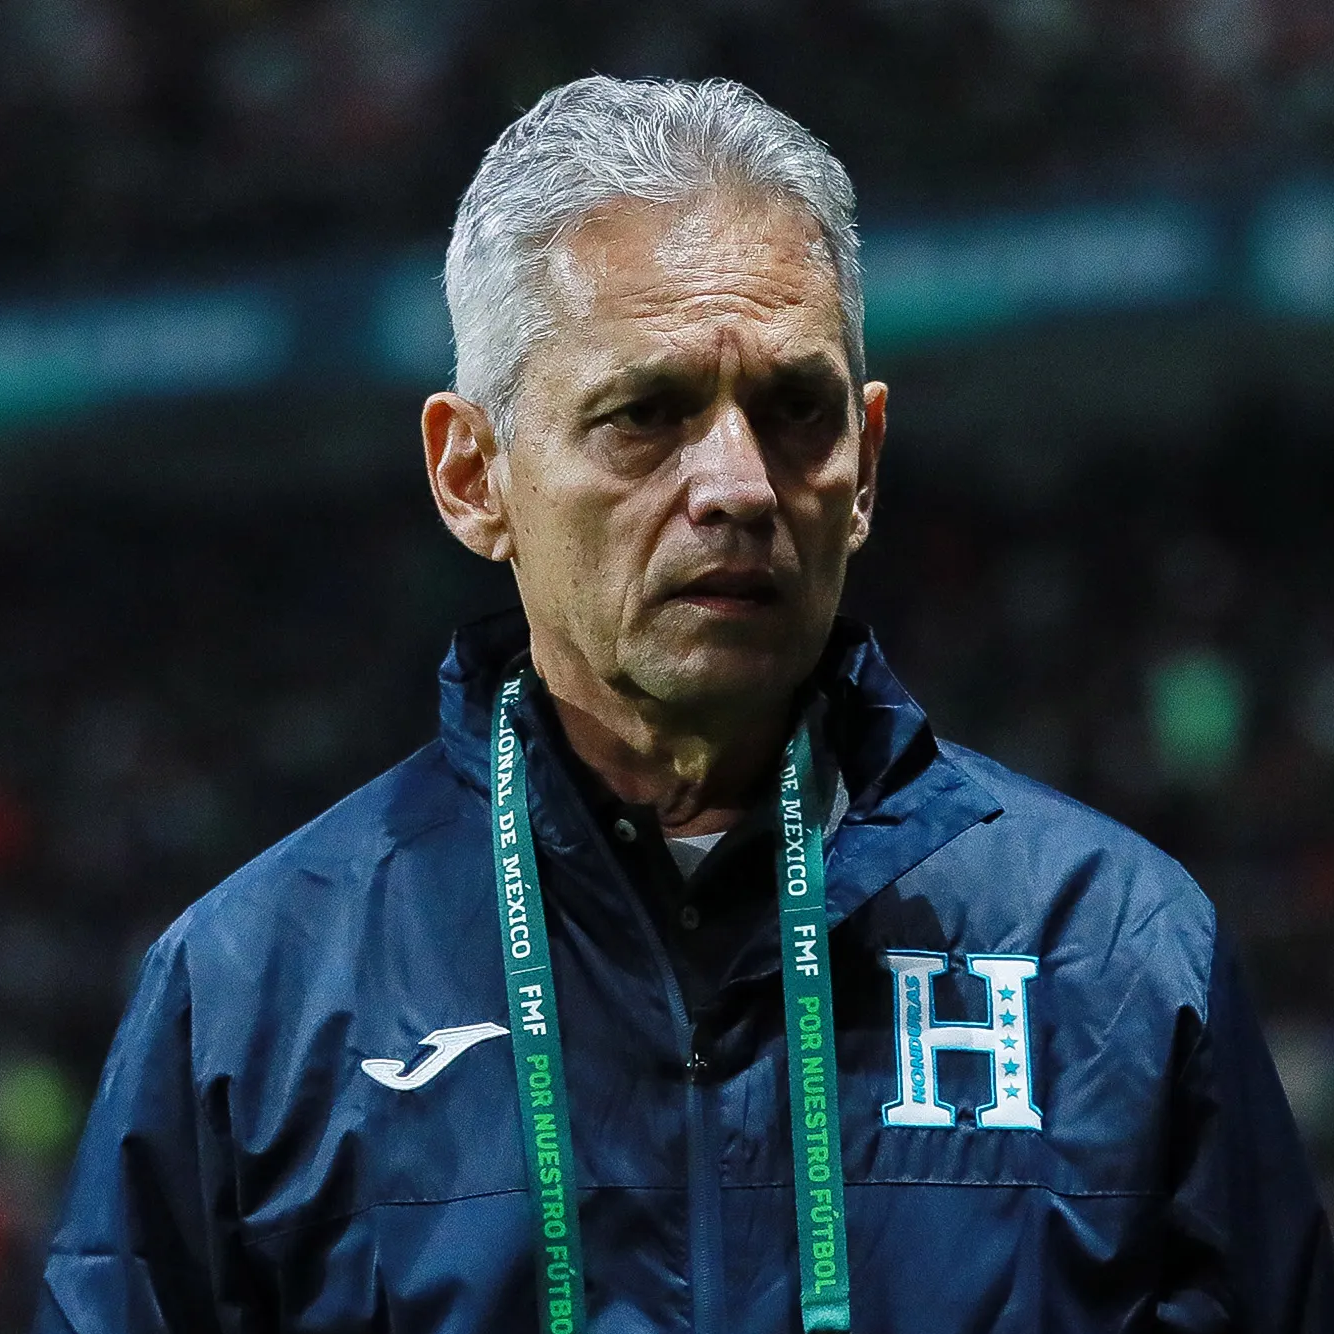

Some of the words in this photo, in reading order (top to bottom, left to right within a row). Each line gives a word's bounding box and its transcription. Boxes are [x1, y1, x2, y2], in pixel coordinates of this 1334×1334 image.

[780, 764, 799, 792] DE
[498, 810, 517, 849] DE
[781, 798, 813, 897] MÉXICO
[502, 853, 532, 959] MÉXICO
[793, 924, 819, 977] FMF
[518, 983, 547, 1036] FMF
[797, 996, 823, 1051] POR
[881, 949, 1044, 1132] H
[904, 974, 926, 1104] HONDURAS
[526, 1054, 554, 1108] POR
[801, 1056, 831, 1183] NUESTRO
[533, 1113, 567, 1239] NUESTRO
[810, 1188, 840, 1295] FÚTBOL
